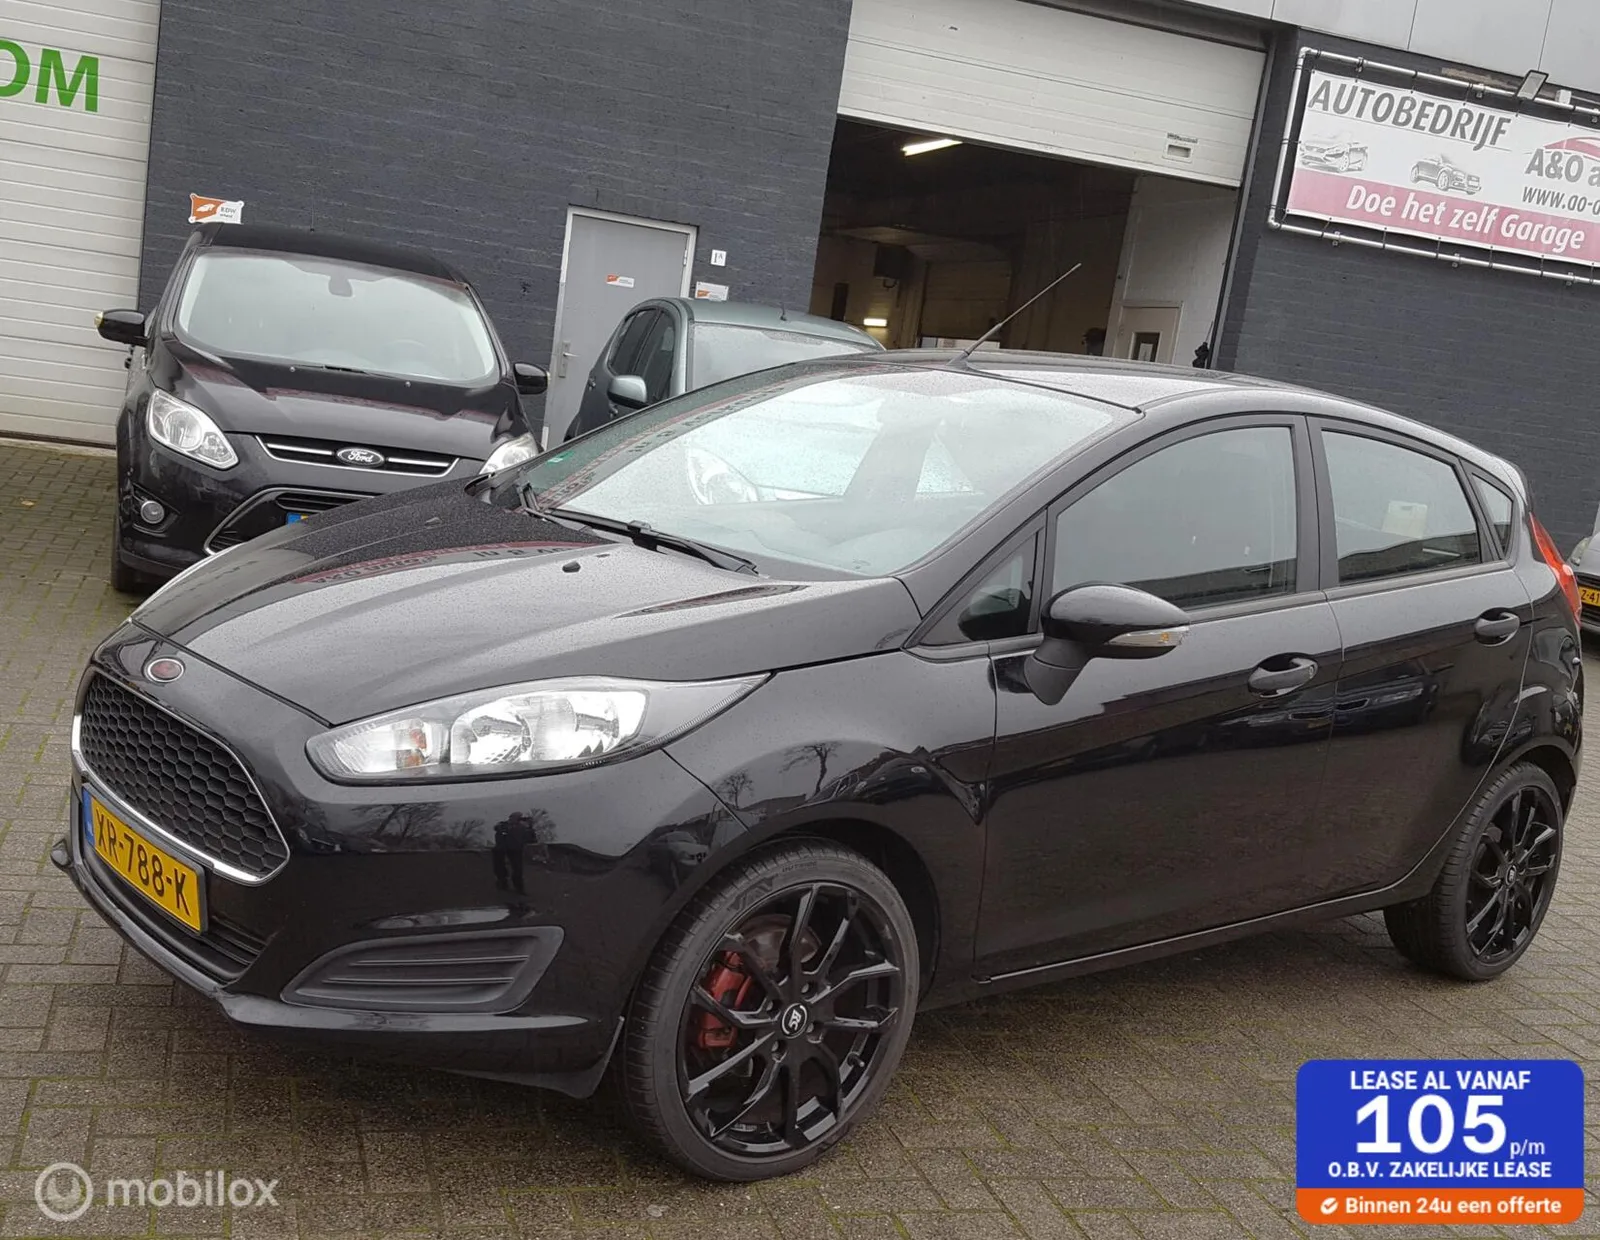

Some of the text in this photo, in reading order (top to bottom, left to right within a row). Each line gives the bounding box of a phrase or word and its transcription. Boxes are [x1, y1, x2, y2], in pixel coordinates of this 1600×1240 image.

[1307, 79, 1512, 151] AUTOBEDRIJF
[1524, 148, 1584, 183] A&O
[1346, 184, 1586, 253] Doe het zelf Garage
[348, 449, 375, 463] Ford
[95, 808, 191, 917] XR-788-K
